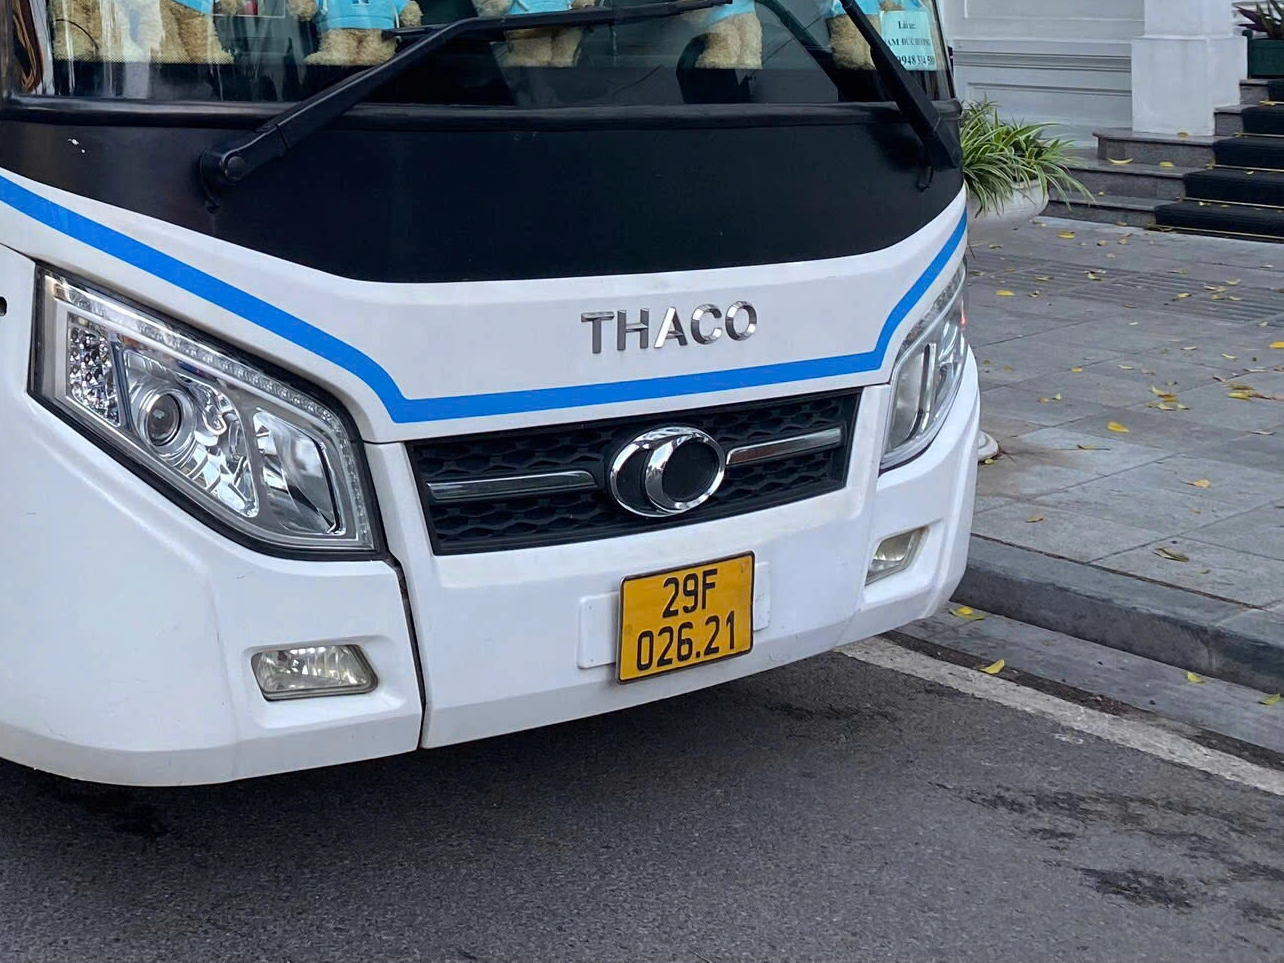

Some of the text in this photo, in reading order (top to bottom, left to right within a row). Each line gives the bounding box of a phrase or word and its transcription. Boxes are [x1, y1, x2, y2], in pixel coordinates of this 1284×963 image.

[581, 300, 757, 354] THACO
[662, 568, 717, 618] 29F
[636, 611, 735, 671] 026.21
